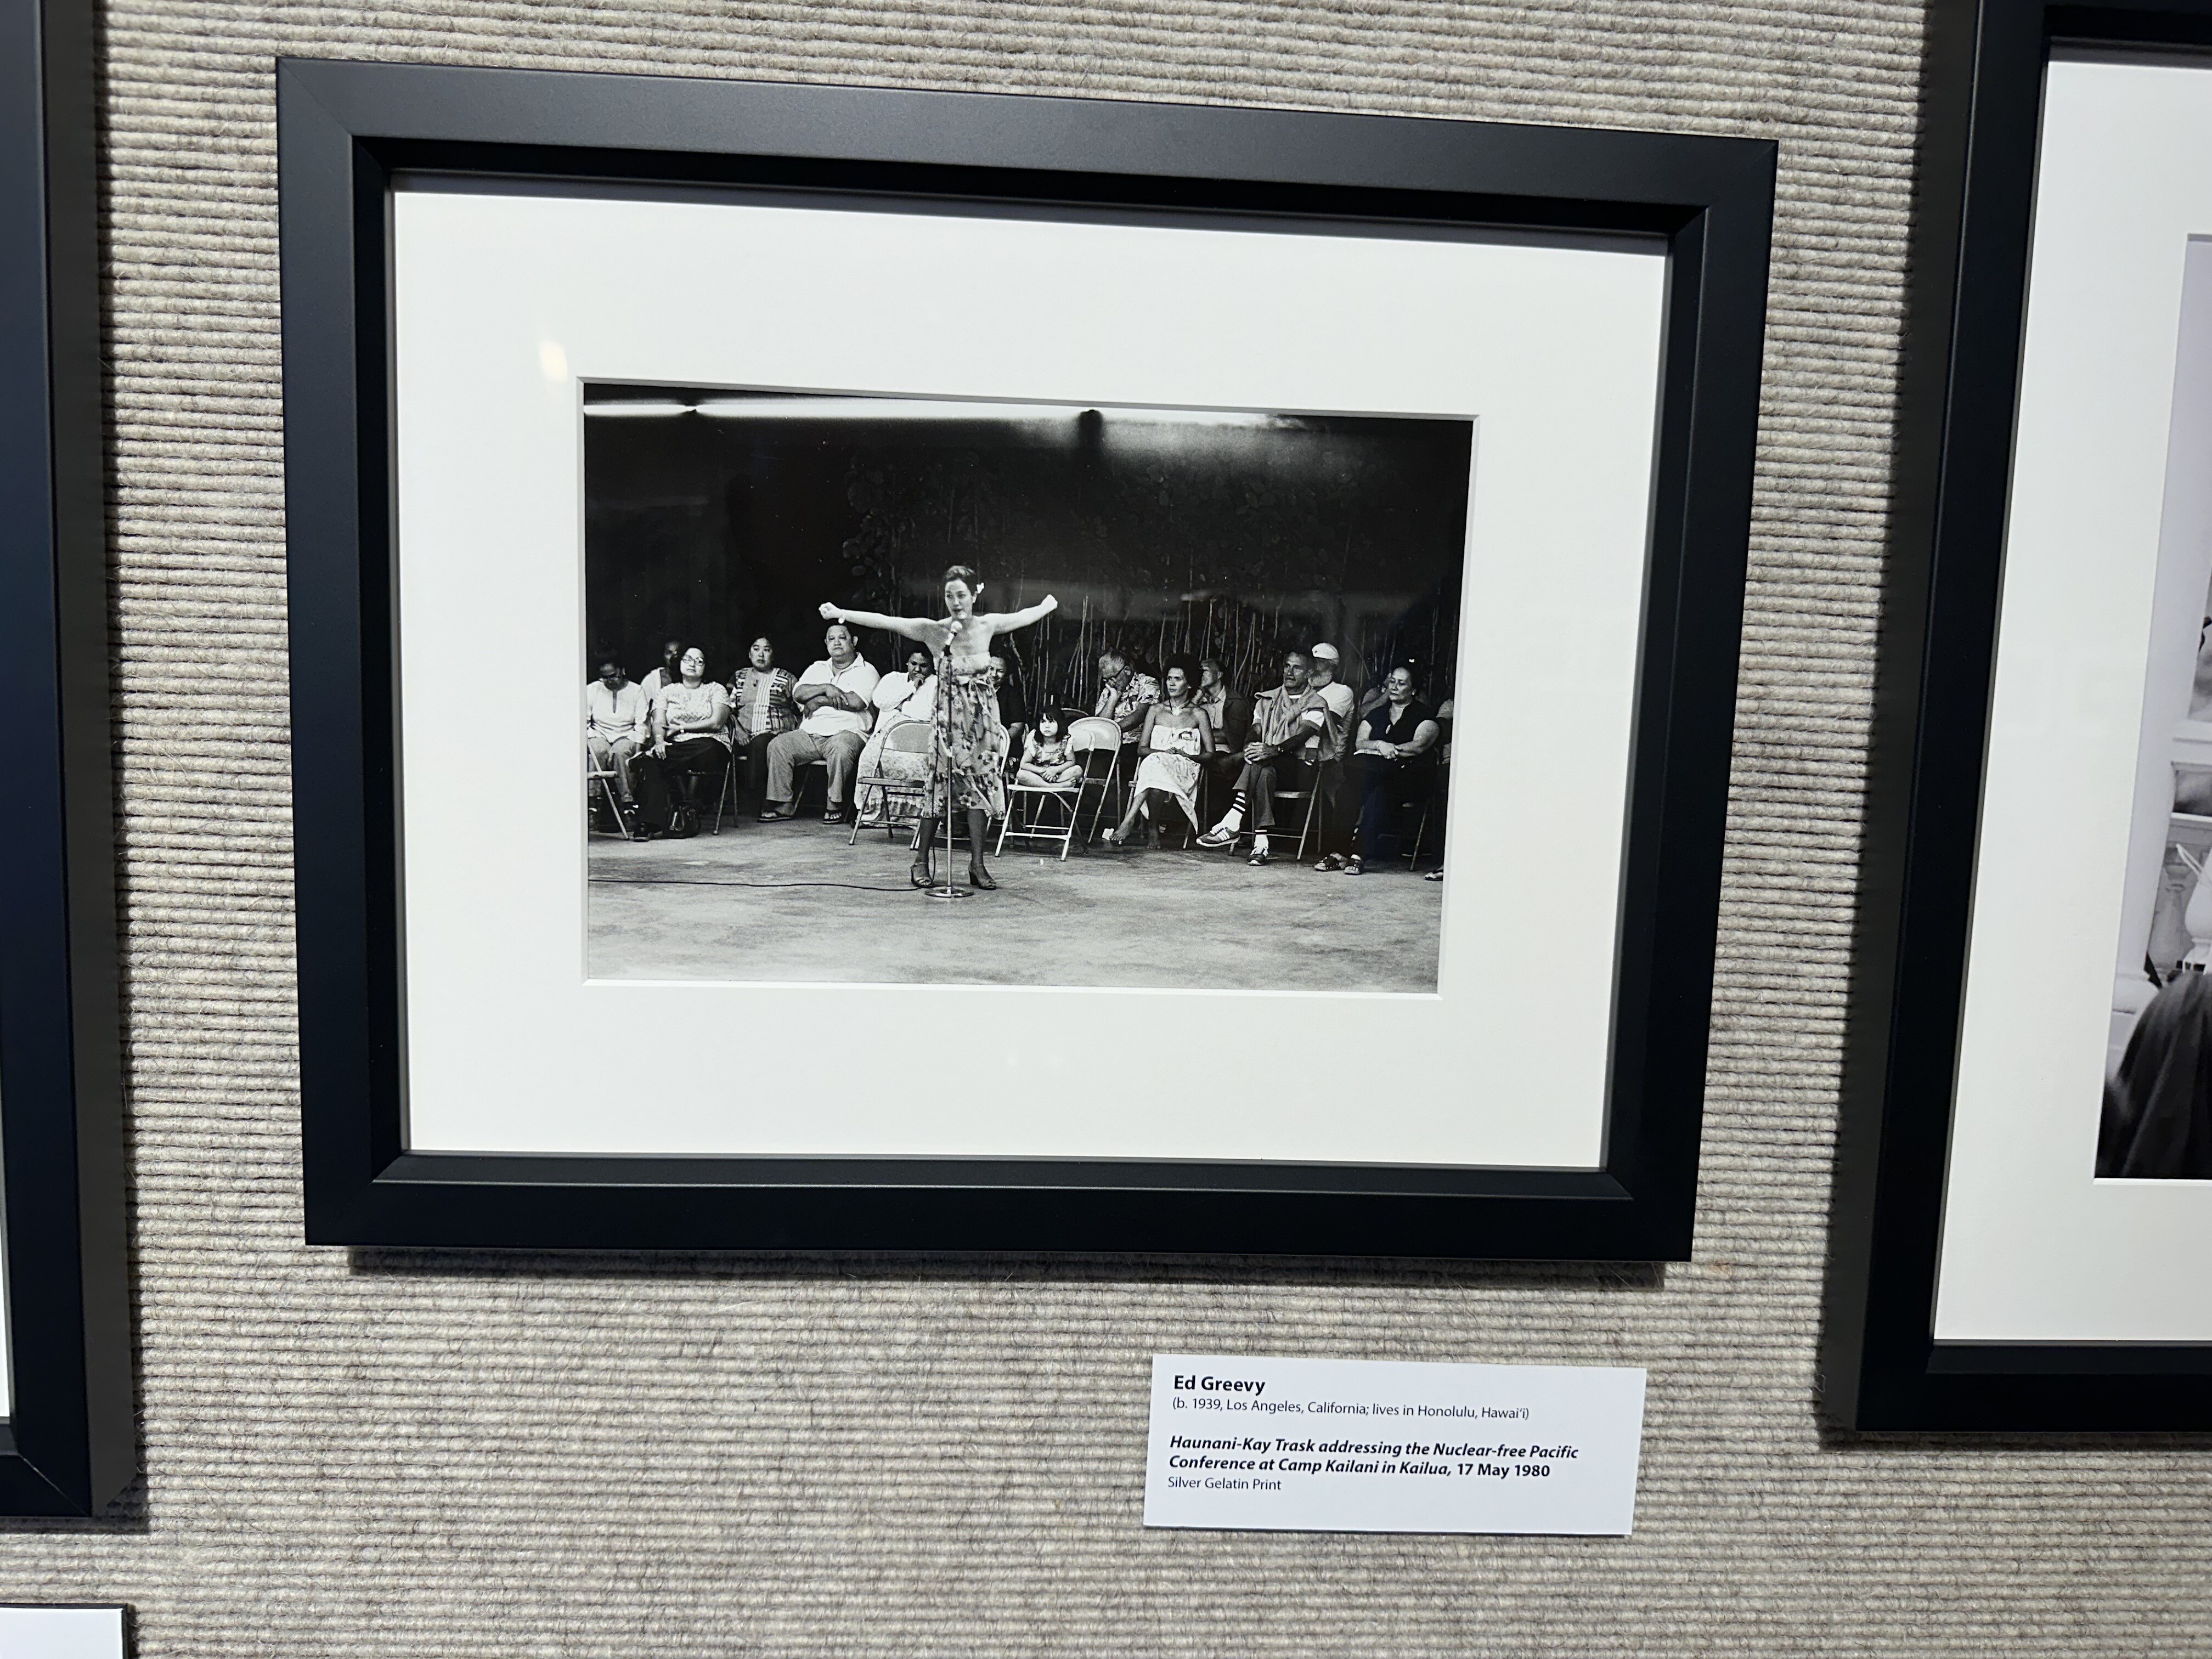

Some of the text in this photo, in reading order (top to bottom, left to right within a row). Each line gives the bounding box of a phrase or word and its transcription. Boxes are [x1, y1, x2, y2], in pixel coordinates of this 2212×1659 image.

[1174, 1374, 1265, 1396] Ed Greevy
[1172, 1396, 1187, 1409] (b.
[1192, 1398, 1222, 1410] 1939,
[1227, 1398, 1247, 1409] Los
[1251, 1400, 1304, 1413] Angeles,
[1307, 1401, 1369, 1415] California;
[1373, 1403, 1399, 1414] lives
[1403, 1404, 1413, 1415] in
[1418, 1405, 1477, 1418] Honolulu,
[1170, 1435, 1578, 1458] Haunani-Kay Trask addressing the Nuclear-free Pacific
[1169, 1454, 1550, 1479] Conference at Camp Kailani in Kailua, 17 May 1980
[1167, 1476, 1282, 1489] Silver Gelatin Print
